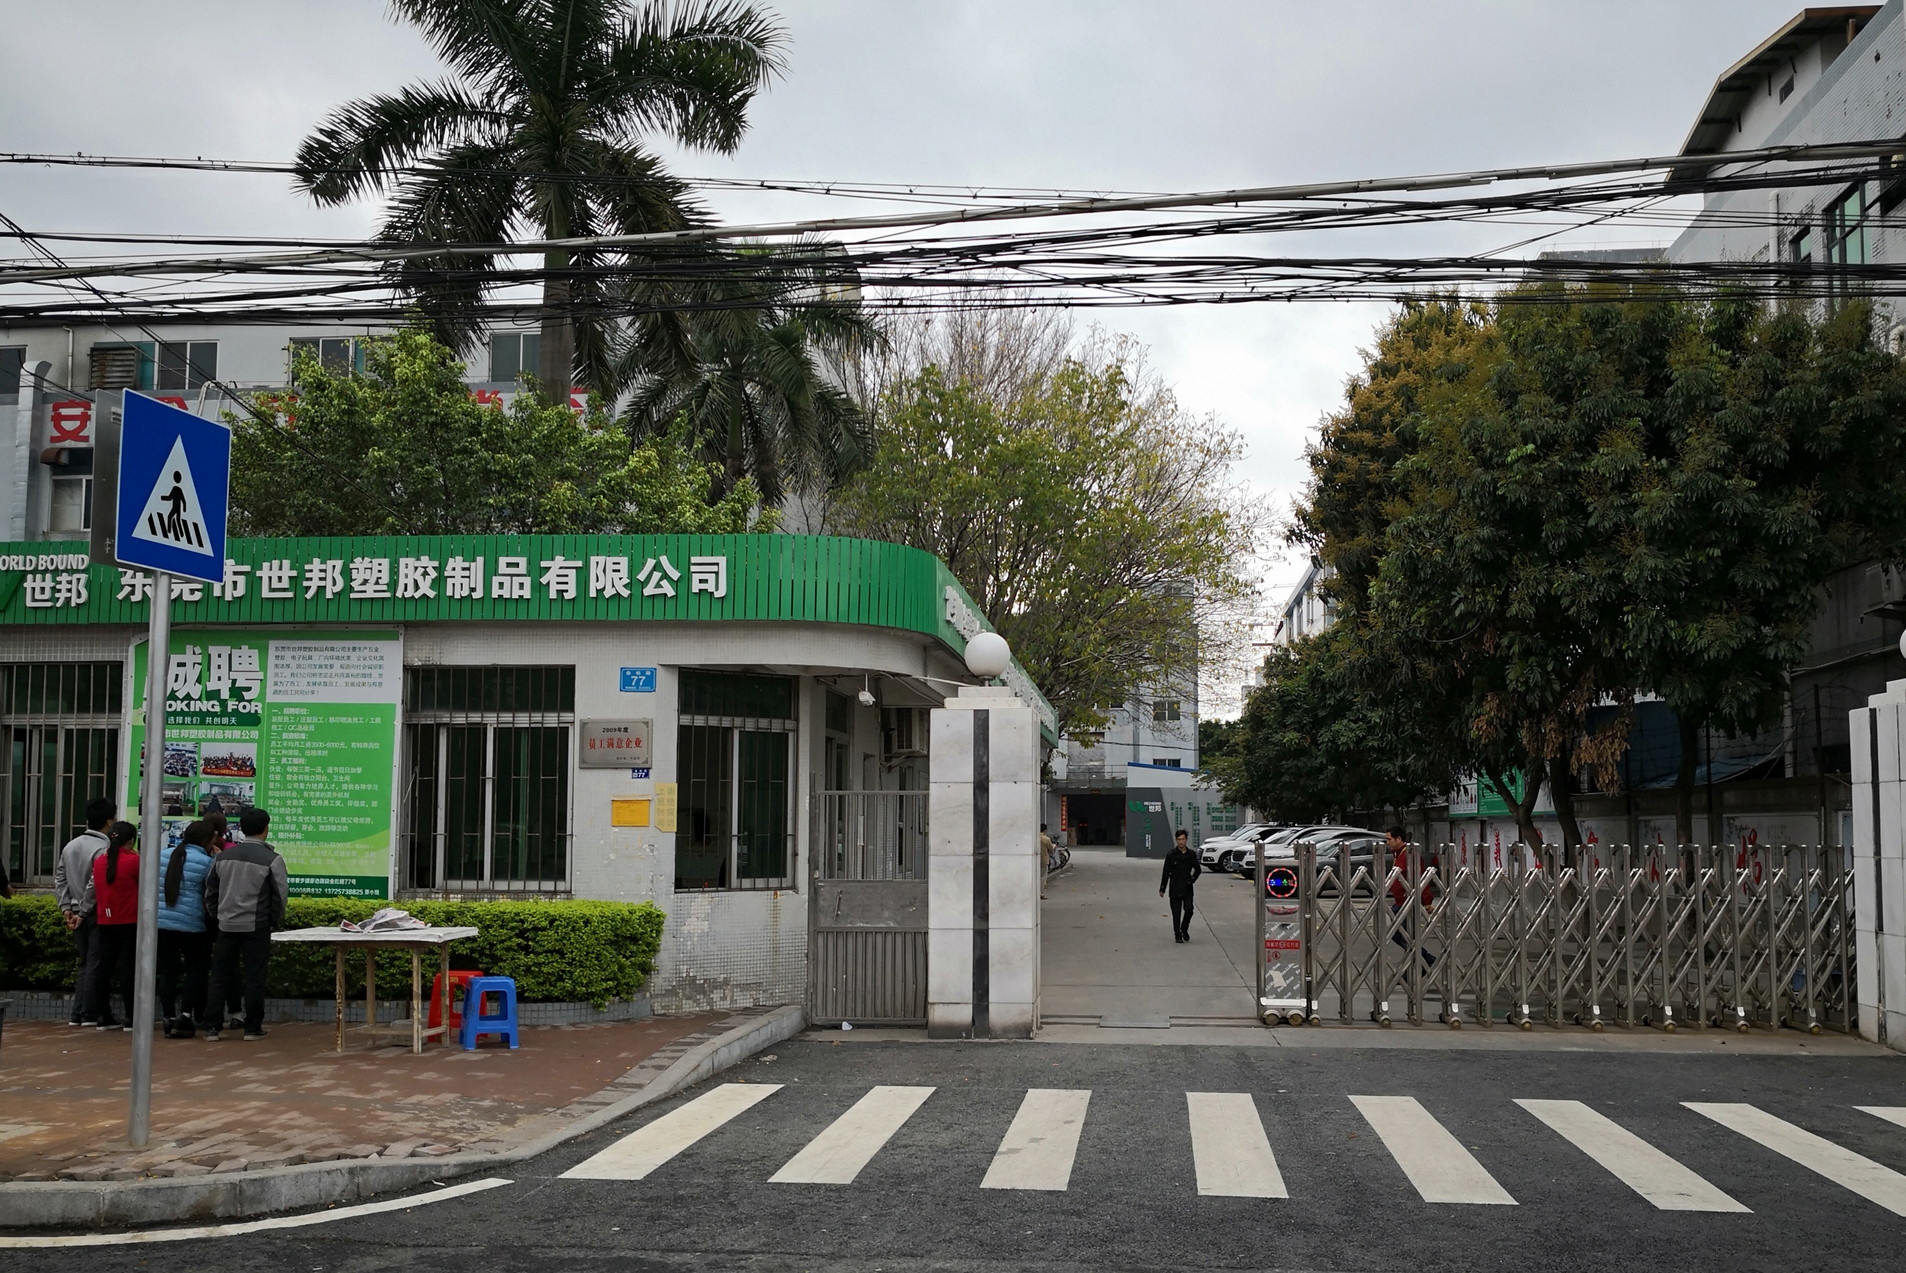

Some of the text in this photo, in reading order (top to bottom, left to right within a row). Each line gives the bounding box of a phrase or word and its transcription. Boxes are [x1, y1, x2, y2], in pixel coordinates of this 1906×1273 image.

[50, 399, 92, 443] 安
[38, 554, 89, 570] BOUND
[23, 572, 89, 608] 世邦
[630, 675, 646, 686] 77
[227, 701, 262, 714] FOR
[167, 716, 238, 725] 选择我们 共创明天
[589, 737, 642, 750] 员工满意企业
